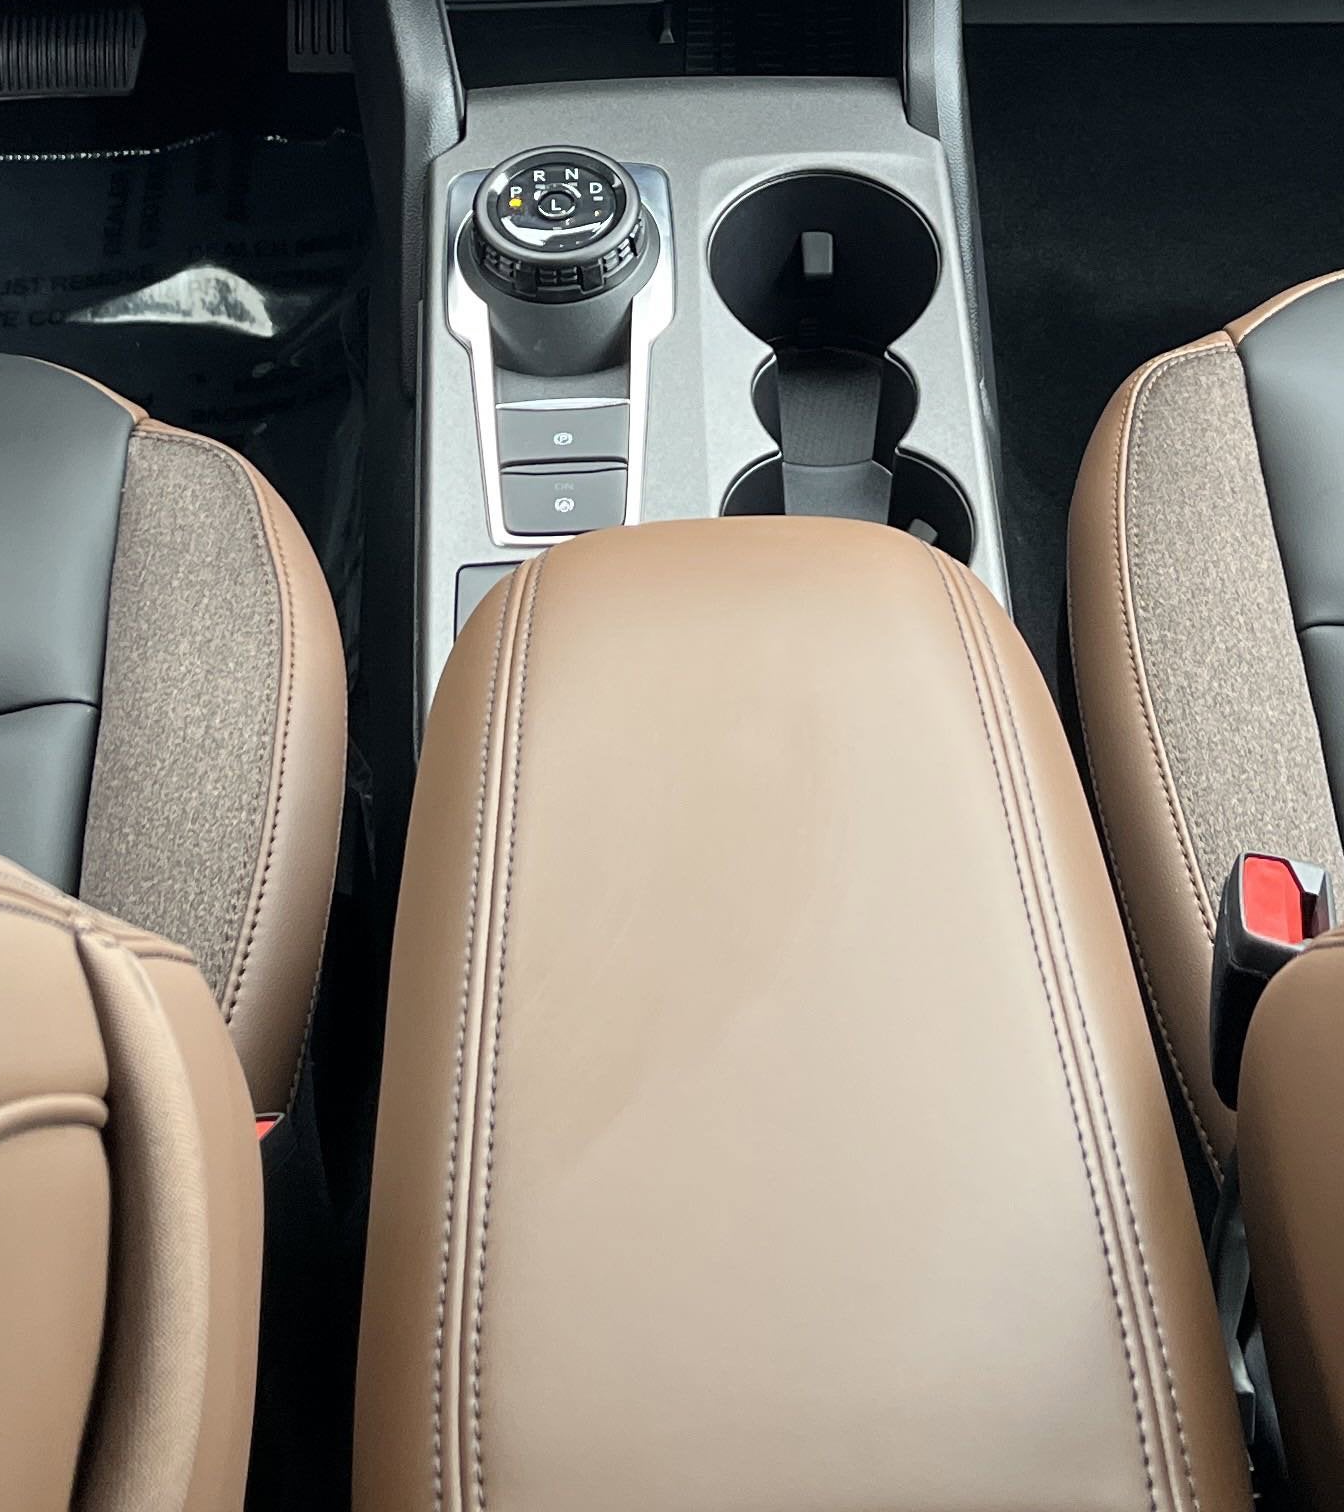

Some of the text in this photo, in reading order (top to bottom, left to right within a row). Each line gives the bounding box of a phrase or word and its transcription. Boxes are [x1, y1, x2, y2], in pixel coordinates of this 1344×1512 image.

[533, 168, 579, 182] R N
[510, 186, 523, 198] P
[589, 182, 603, 194] D
[551, 199, 562, 211] L
